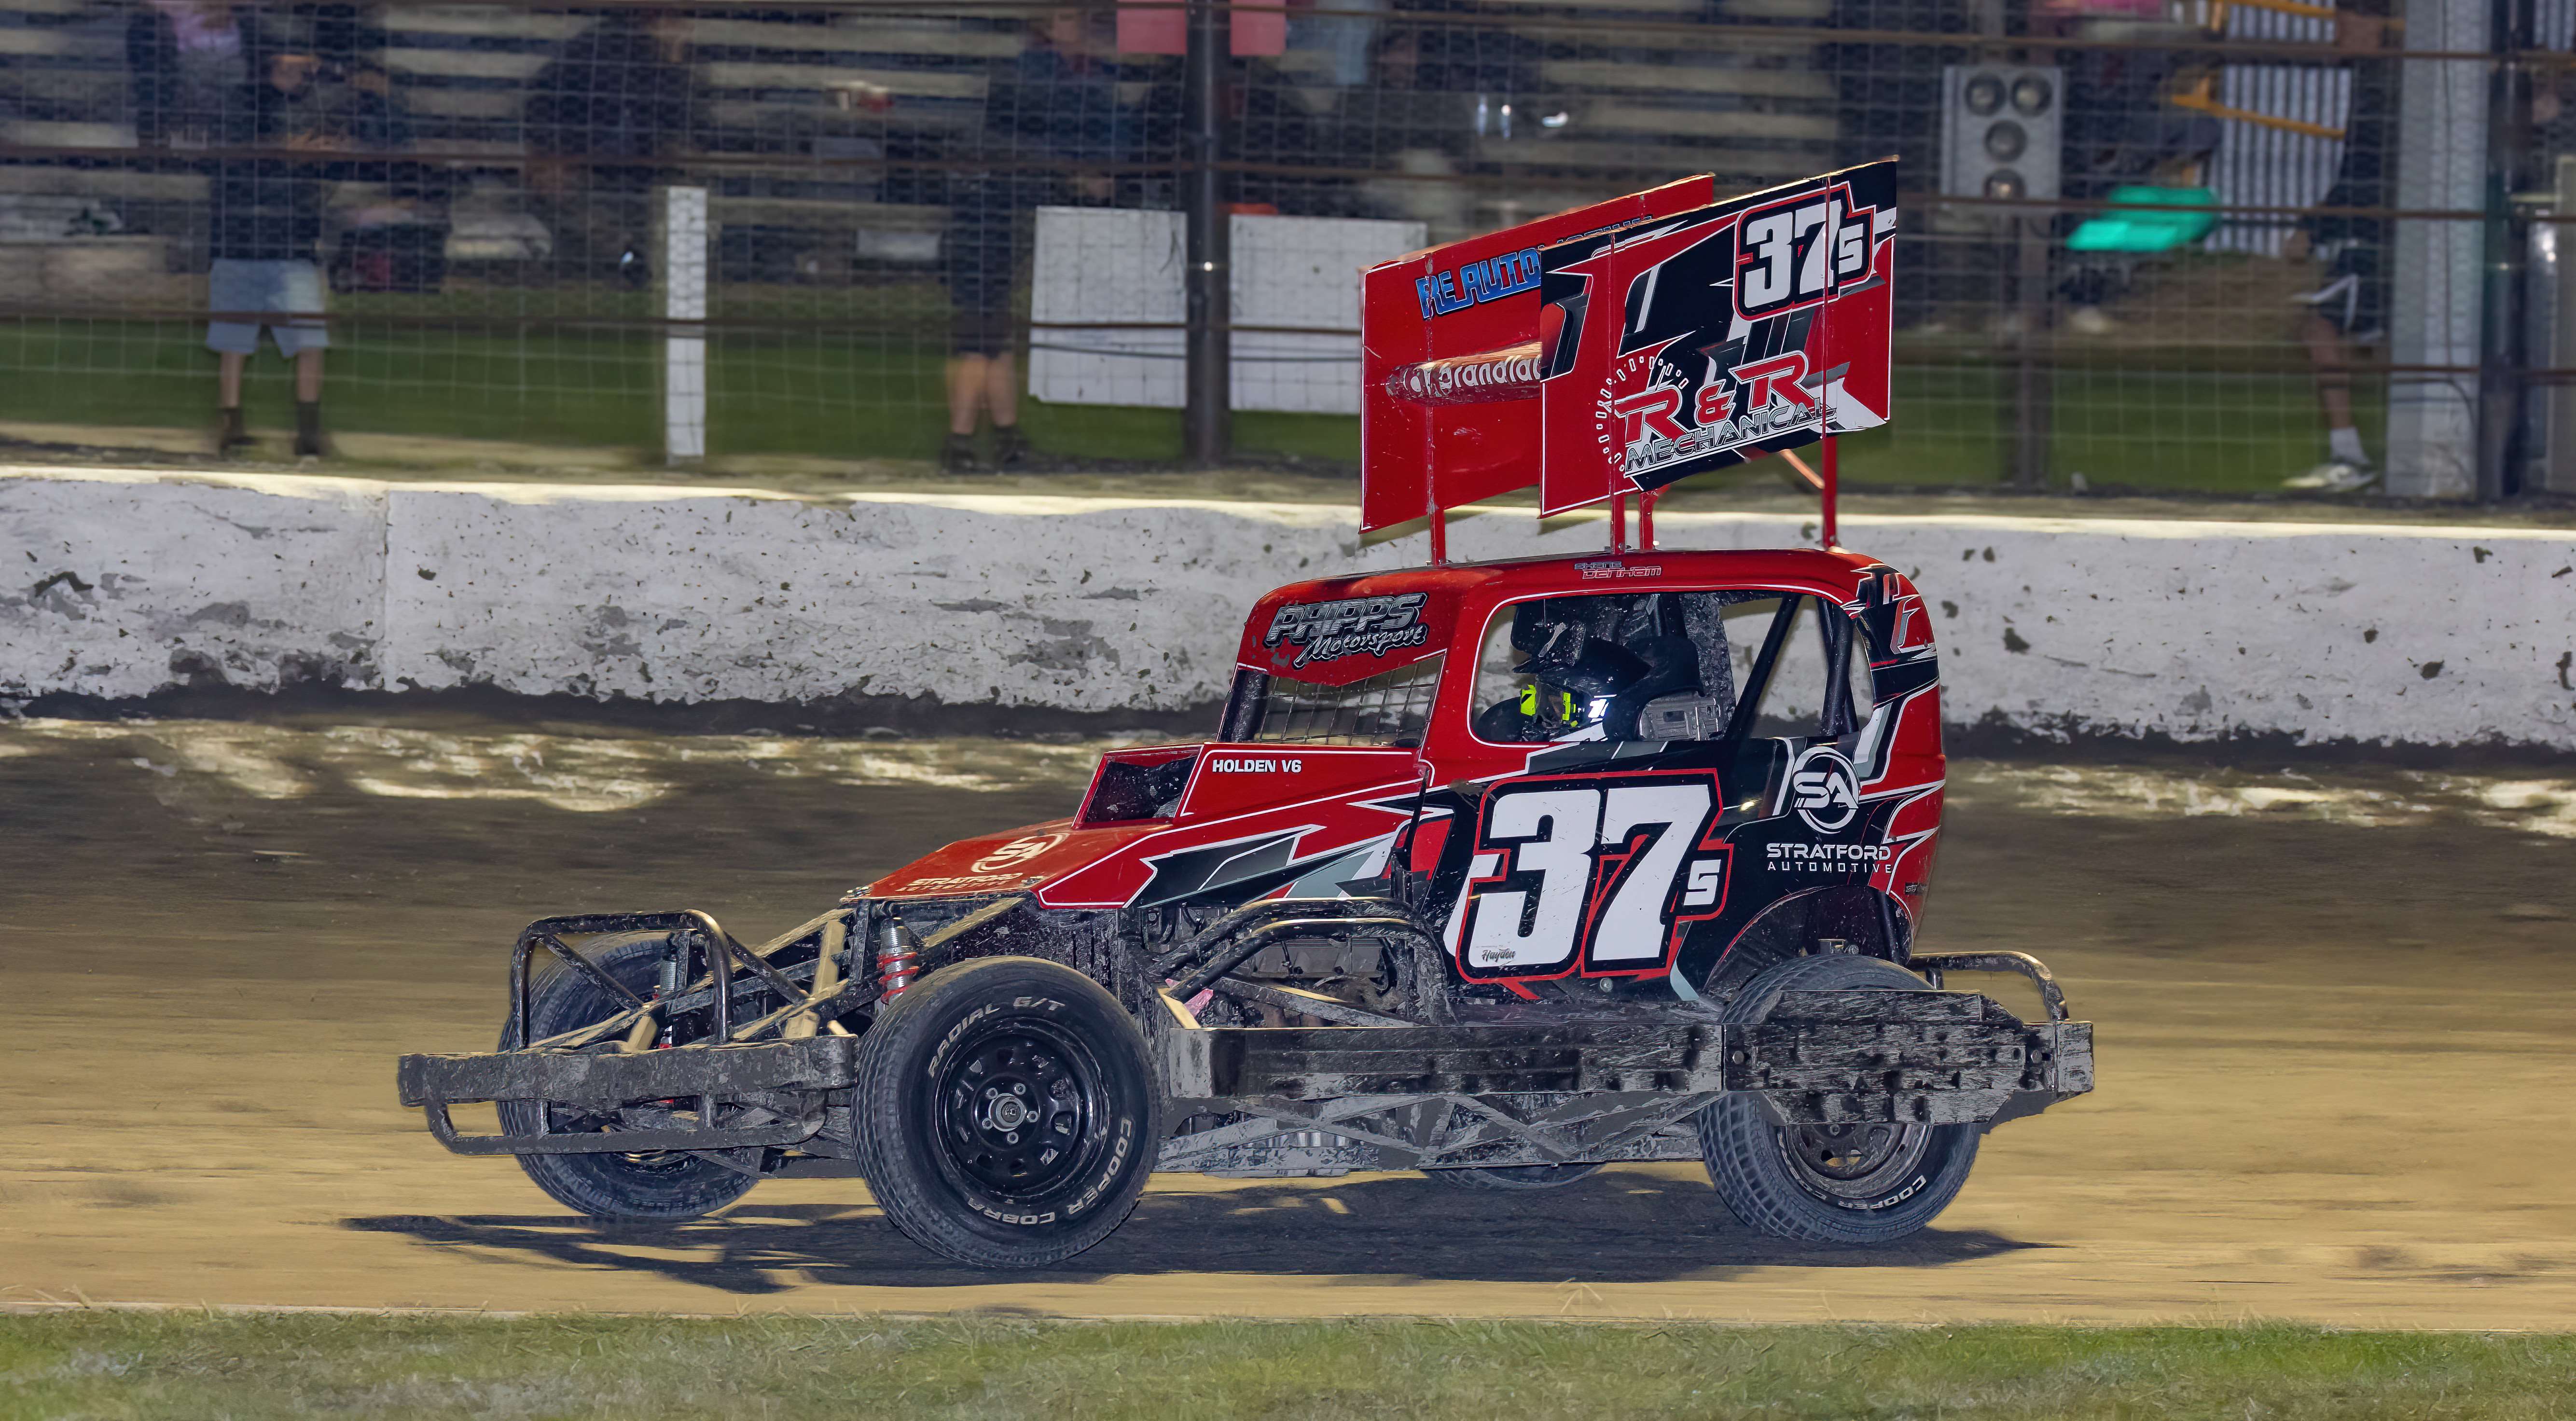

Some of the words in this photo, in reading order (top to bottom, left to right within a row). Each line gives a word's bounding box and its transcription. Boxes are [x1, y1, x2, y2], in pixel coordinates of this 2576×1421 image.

[1458, 247, 1545, 303] AUTO
[1615, 385, 1690, 445] R
[1693, 379, 1736, 426] &
[1728, 350, 1819, 414] R
[1624, 396, 1837, 473] MECHANICAL
[1295, 624, 1425, 664] Motorsport
[1212, 759, 1276, 773] HOLDEN
[1281, 759, 1302, 773] V6
[1766, 843, 1891, 861] STRATFORD
[1767, 861, 1892, 873] AUTOMOTIVE
[928, 1003, 1000, 1078] RADIAL
[1013, 996, 1066, 1011] G/T
[1067, 1117, 1132, 1215] COOPER
[968, 1197, 1055, 1225] COBRA
[1837, 1174, 1927, 1210] COOPER
